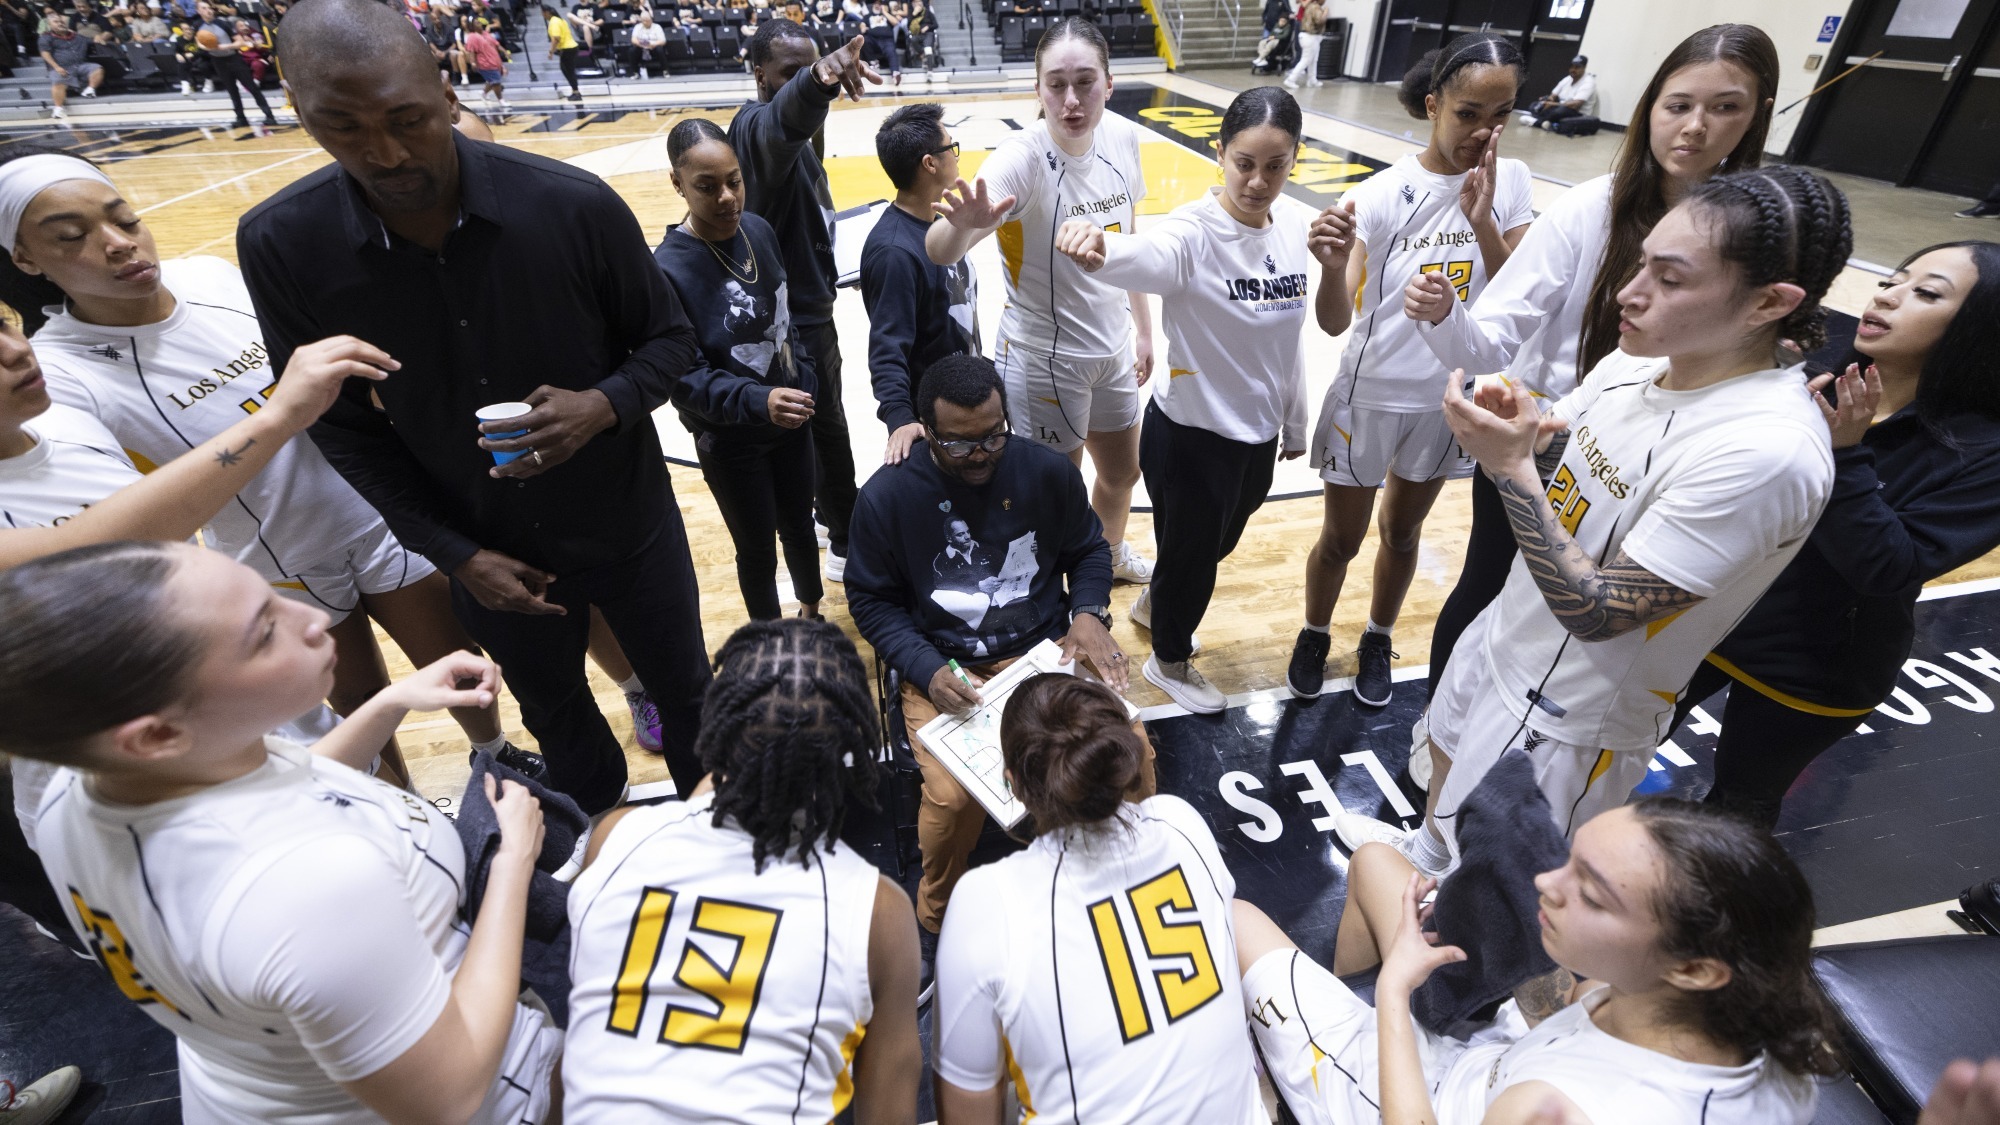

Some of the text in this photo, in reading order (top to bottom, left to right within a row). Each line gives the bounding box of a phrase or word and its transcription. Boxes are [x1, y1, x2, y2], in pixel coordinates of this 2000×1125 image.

[1064, 192, 1127, 217] Los Angeles
[1402, 229, 1478, 252] Los Ange
[1225, 277, 1261, 301] LOS
[166, 378, 218, 411] Los
[211, 341, 271, 386] Angel
[1039, 426, 1062, 444] LA
[1546, 462, 1592, 538] 24
[1581, 437, 1630, 500] Angeles
[605, 885, 784, 1056] 13
[1086, 863, 1224, 1045] 15
